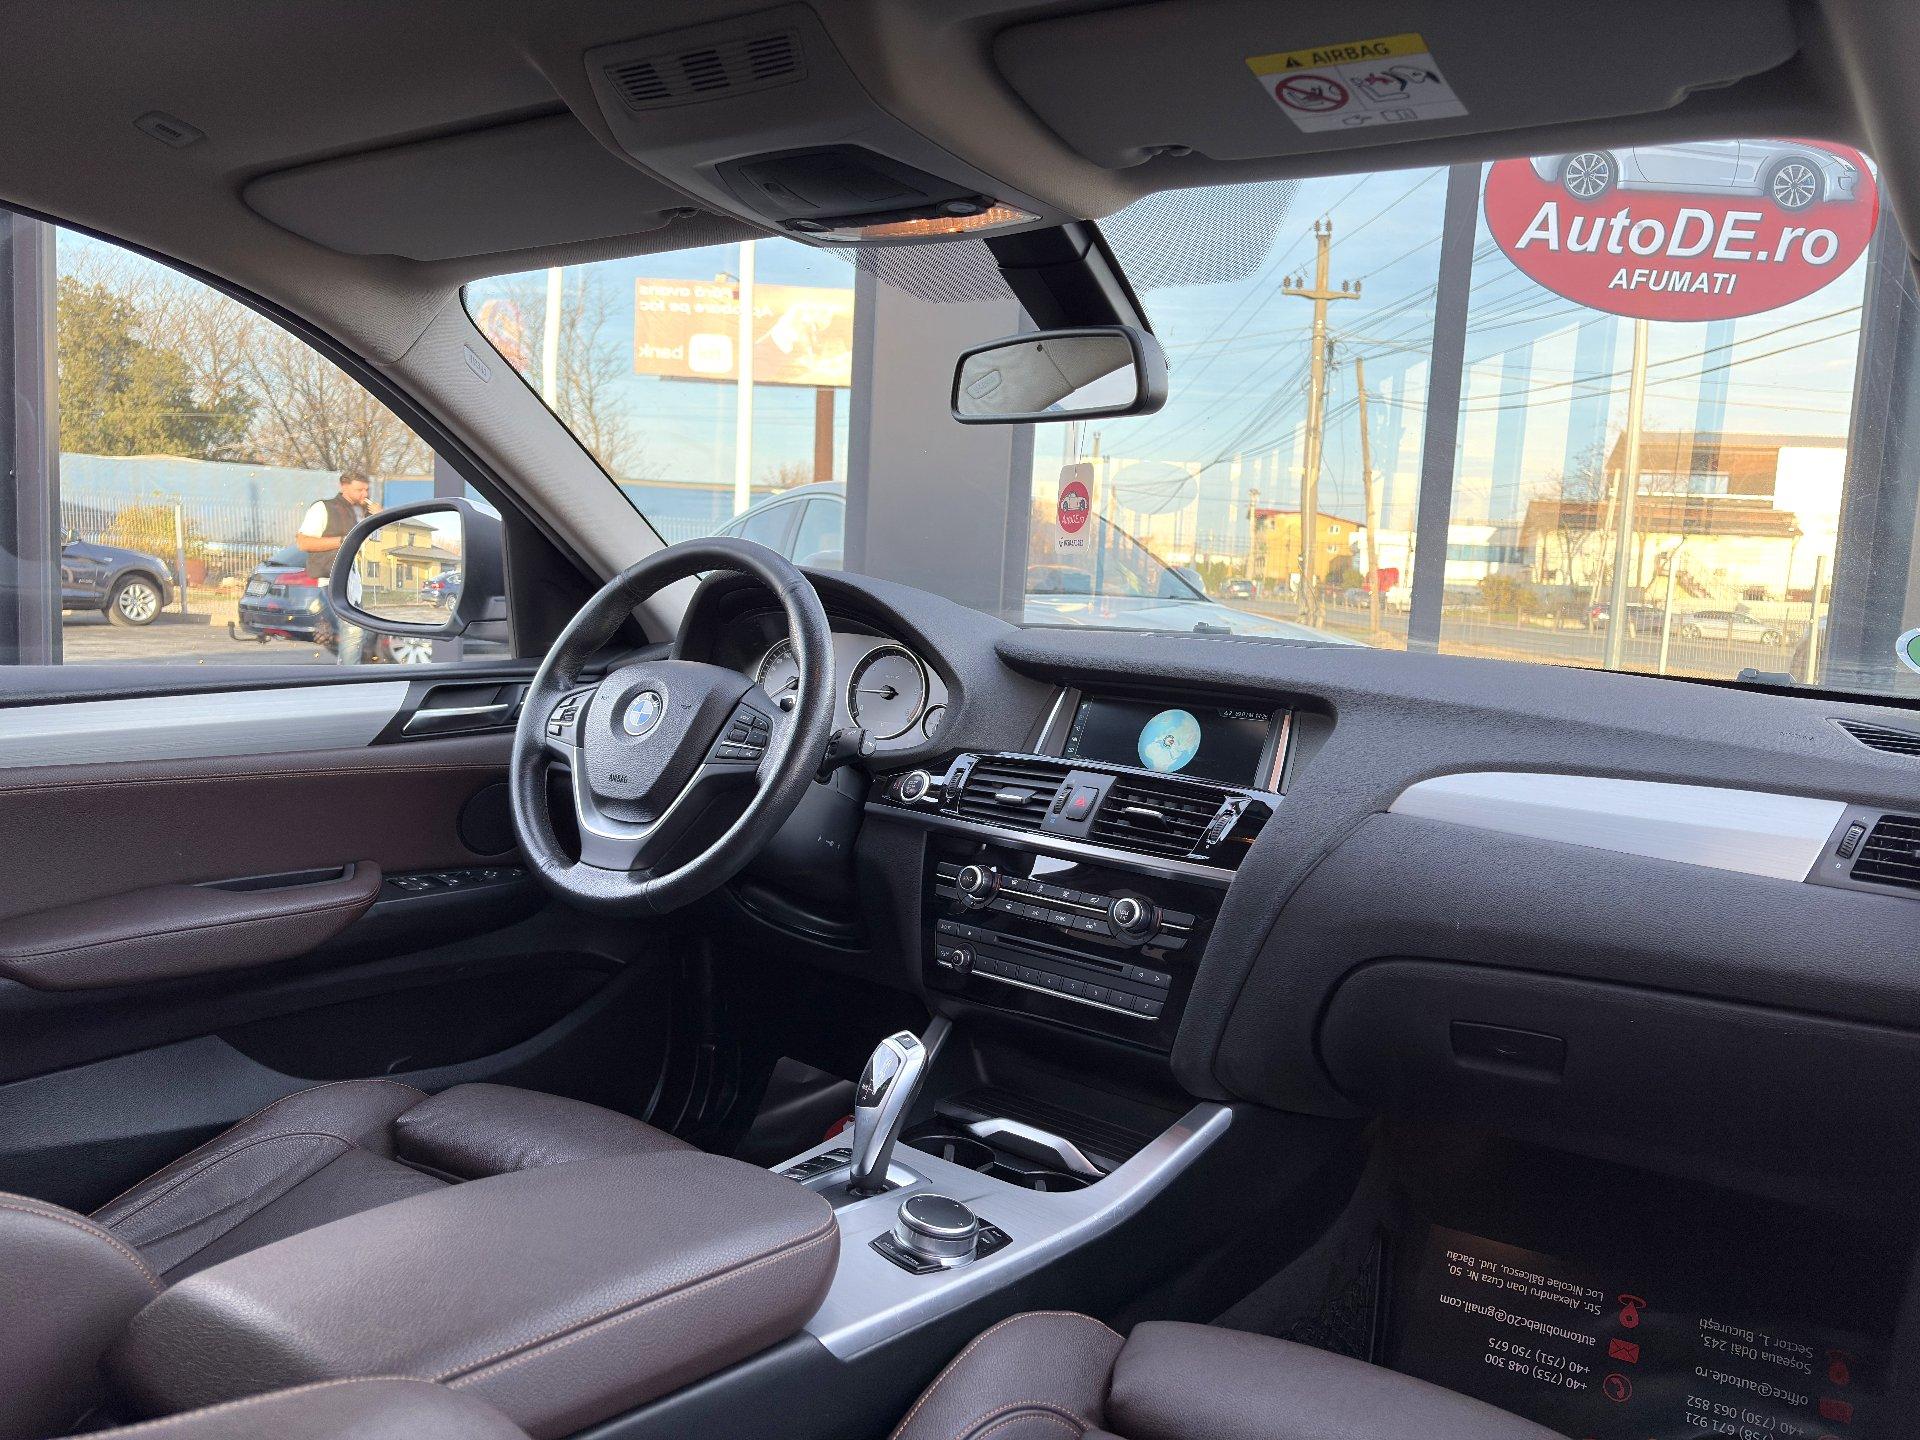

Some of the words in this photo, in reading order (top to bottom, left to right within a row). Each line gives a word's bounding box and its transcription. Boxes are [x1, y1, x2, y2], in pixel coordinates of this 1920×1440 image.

[1312, 43, 1390, 65] AIRBAG
[1515, 201, 1839, 265] AutoDE.ro
[1608, 268, 1737, 295] AFUMATI
[1466, 1270, 1478, 1281] Nr.
[1482, 1274, 1503, 1288] Cuza
[1507, 1281, 1527, 1294] Ioan
[1547, 1278, 1583, 1294] Nicolae
[1531, 1288, 1579, 1308] Alexandru
[1586, 1288, 1603, 1300] Loc
[1583, 1302, 1601, 1314] Str.
[1440, 1294, 1596, 1346] automobilebc20@gmail.com
[1488, 1338, 1508, 1351] 675
[1512, 1345, 1531, 1358] 750
[1773, 1338, 1813, 1358] Sector
[1485, 1353, 1504, 1368] 300
[1508, 1360, 1529, 1374] 048
[1535, 1350, 1566, 1369] (751)
[1569, 1362, 1590, 1373] +40
[1532, 1366, 1562, 1386] (753)
[1566, 1378, 1587, 1390] +40
[1695, 1366, 1808, 1406] office@autode.ro
[1687, 1395, 1710, 1410] 852
[1714, 1404, 1737, 1418] 063
[1685, 1412, 1708, 1427] 921
[1713, 1420, 1735, 1434] 671
[1742, 1409, 1775, 1430] (730)
[1780, 1422, 1804, 1435] +40
